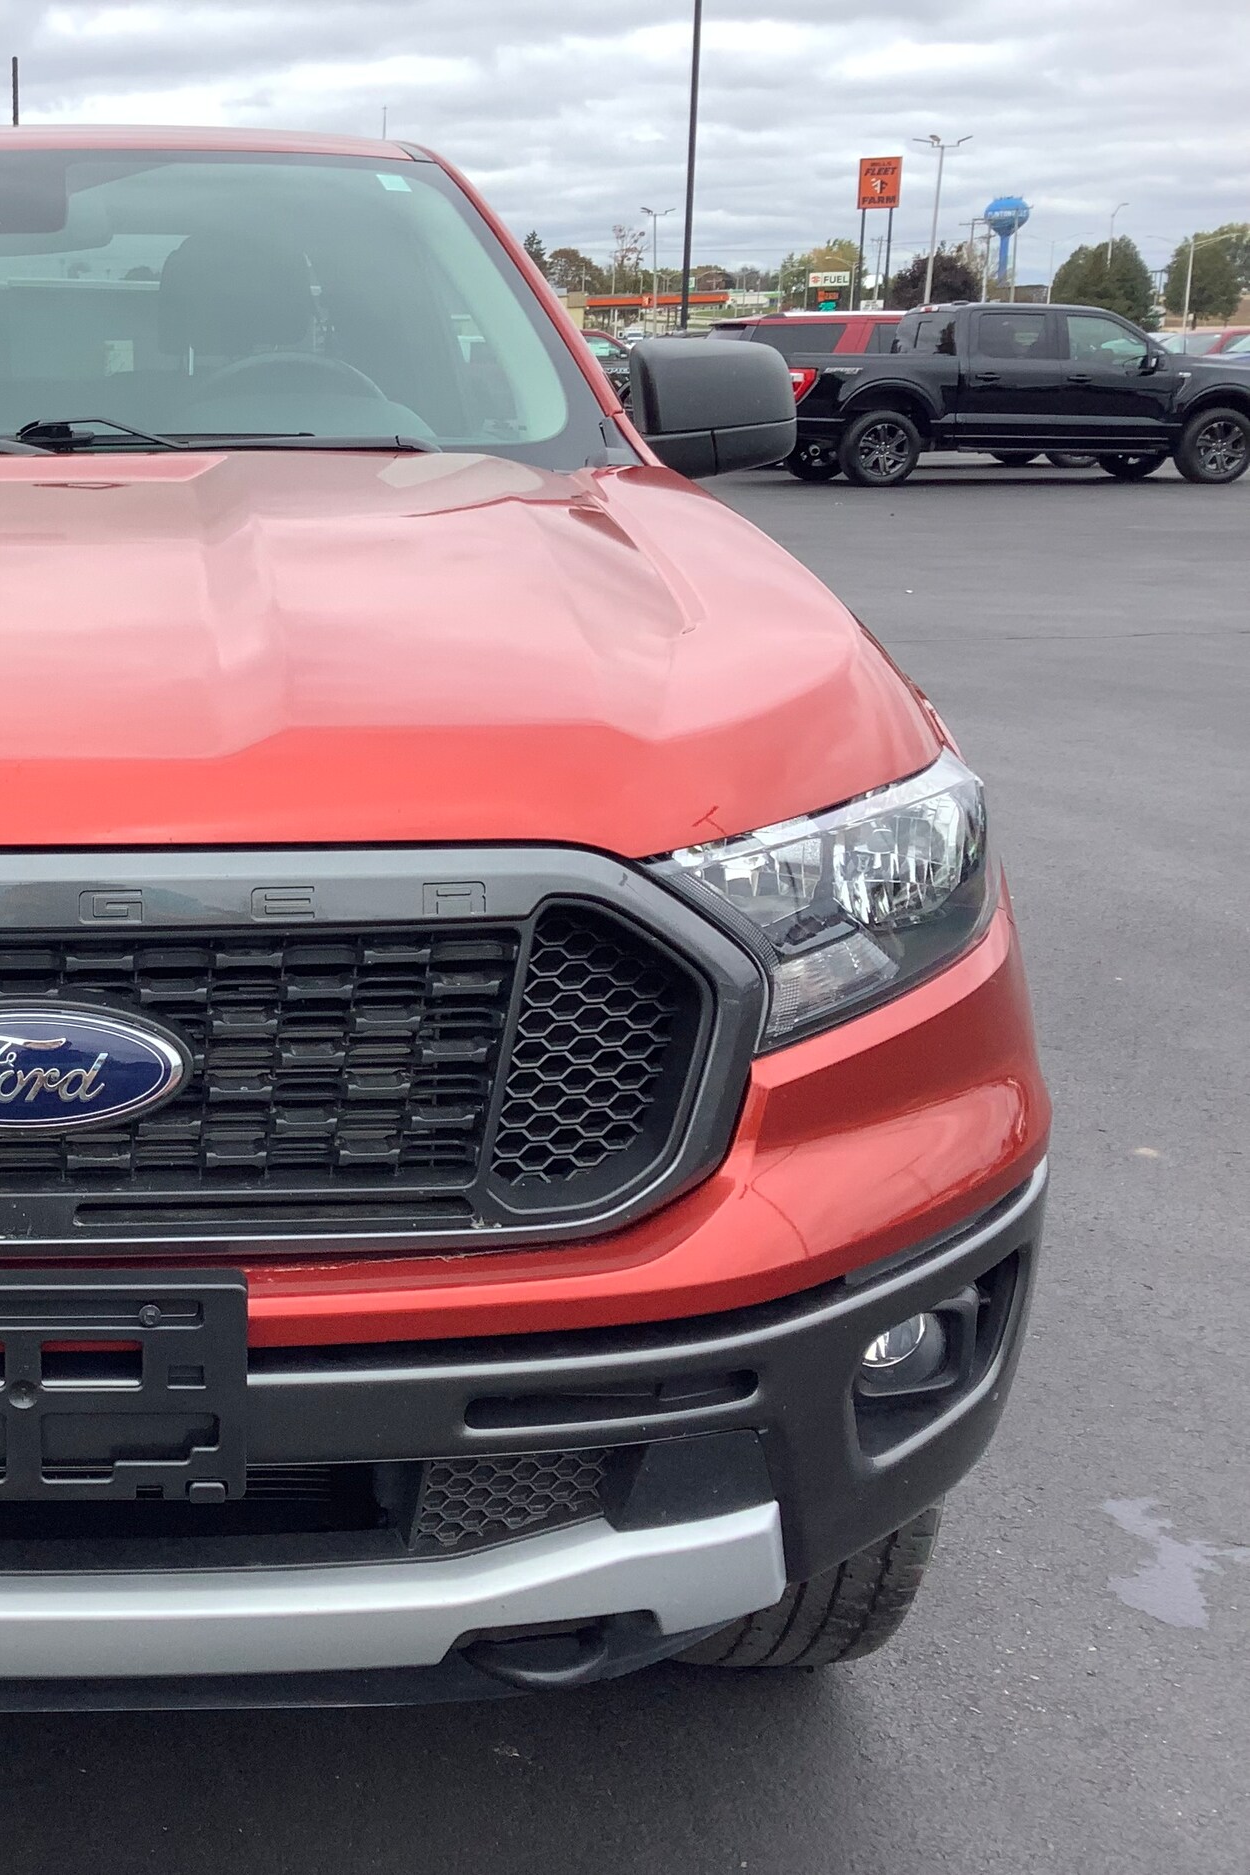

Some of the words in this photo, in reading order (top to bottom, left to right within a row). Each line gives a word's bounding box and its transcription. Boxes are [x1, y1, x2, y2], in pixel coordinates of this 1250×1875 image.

[864, 166, 897, 176] FLEET
[862, 196, 895, 205] FARM
[823, 275, 849, 284] FUEL
